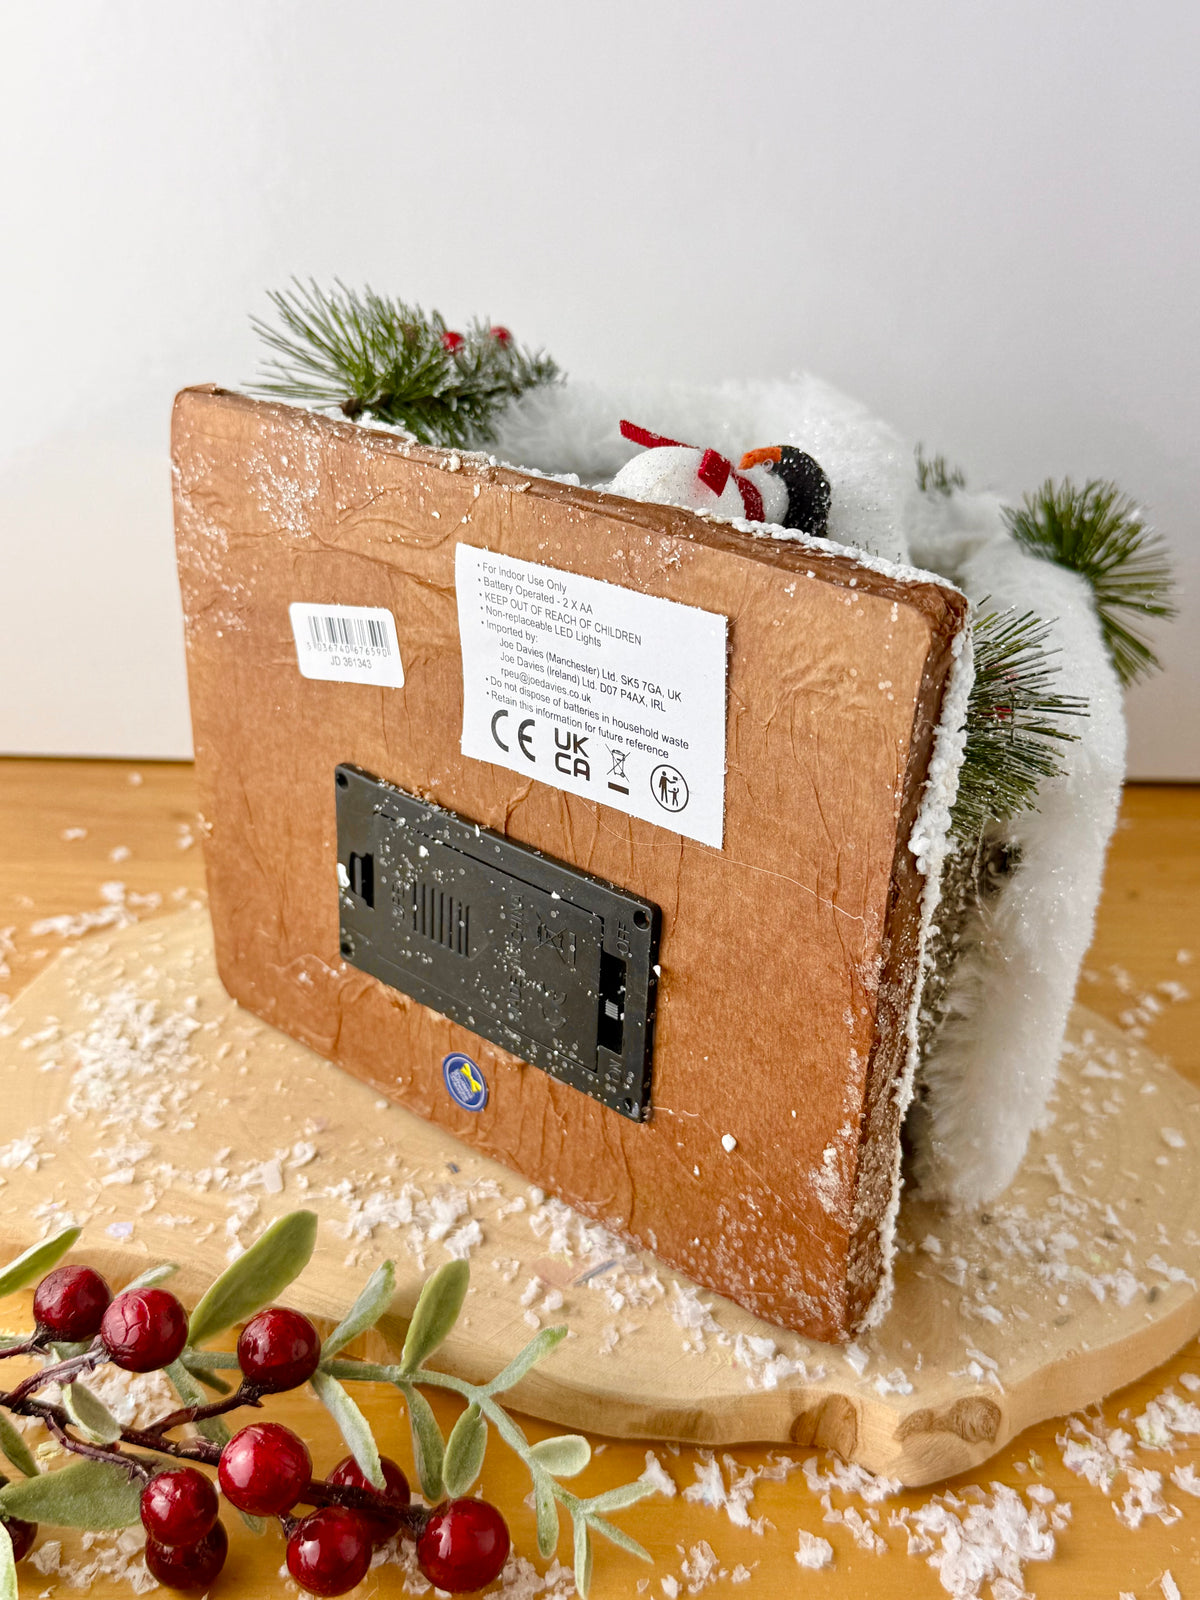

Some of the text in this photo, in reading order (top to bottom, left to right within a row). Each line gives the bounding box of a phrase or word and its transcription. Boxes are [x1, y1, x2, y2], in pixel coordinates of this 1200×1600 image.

[482, 562, 567, 595] For Indoor Use Only
[483, 576, 513, 595] Battery
[516, 585, 555, 604] Operated
[563, 597, 569, 608] 2
[571, 599, 578, 611] X
[580, 602, 594, 615] AA
[485, 591, 642, 646] KEEP OUT OF REACH OF CHILDREN
[485, 605, 602, 647] Non-replaceable LED Lights
[486, 619, 538, 644] Imported by:
[318, 642, 350, 654] 036740
[354, 646, 387, 658] 676590
[331, 655, 341, 666] JD
[499, 638, 682, 702] Joe Davies (Manchester) Ltd. SK5 7GA, UK
[500, 651, 667, 712] Joe Davies (Ireland) Ltd. D07 P4AX, IRL
[501, 667, 592, 703] rpeu@joedavies.co.uk
[490, 676, 689, 750] Do not dispose of batteries in household waste
[491, 690, 669, 759] Retain this information for future reference
[491, 709, 536, 763] CE
[554, 727, 590, 758] UK
[554, 751, 590, 782] CA
[616, 920, 631, 954] OFF
[608, 1058, 622, 1084] ON
